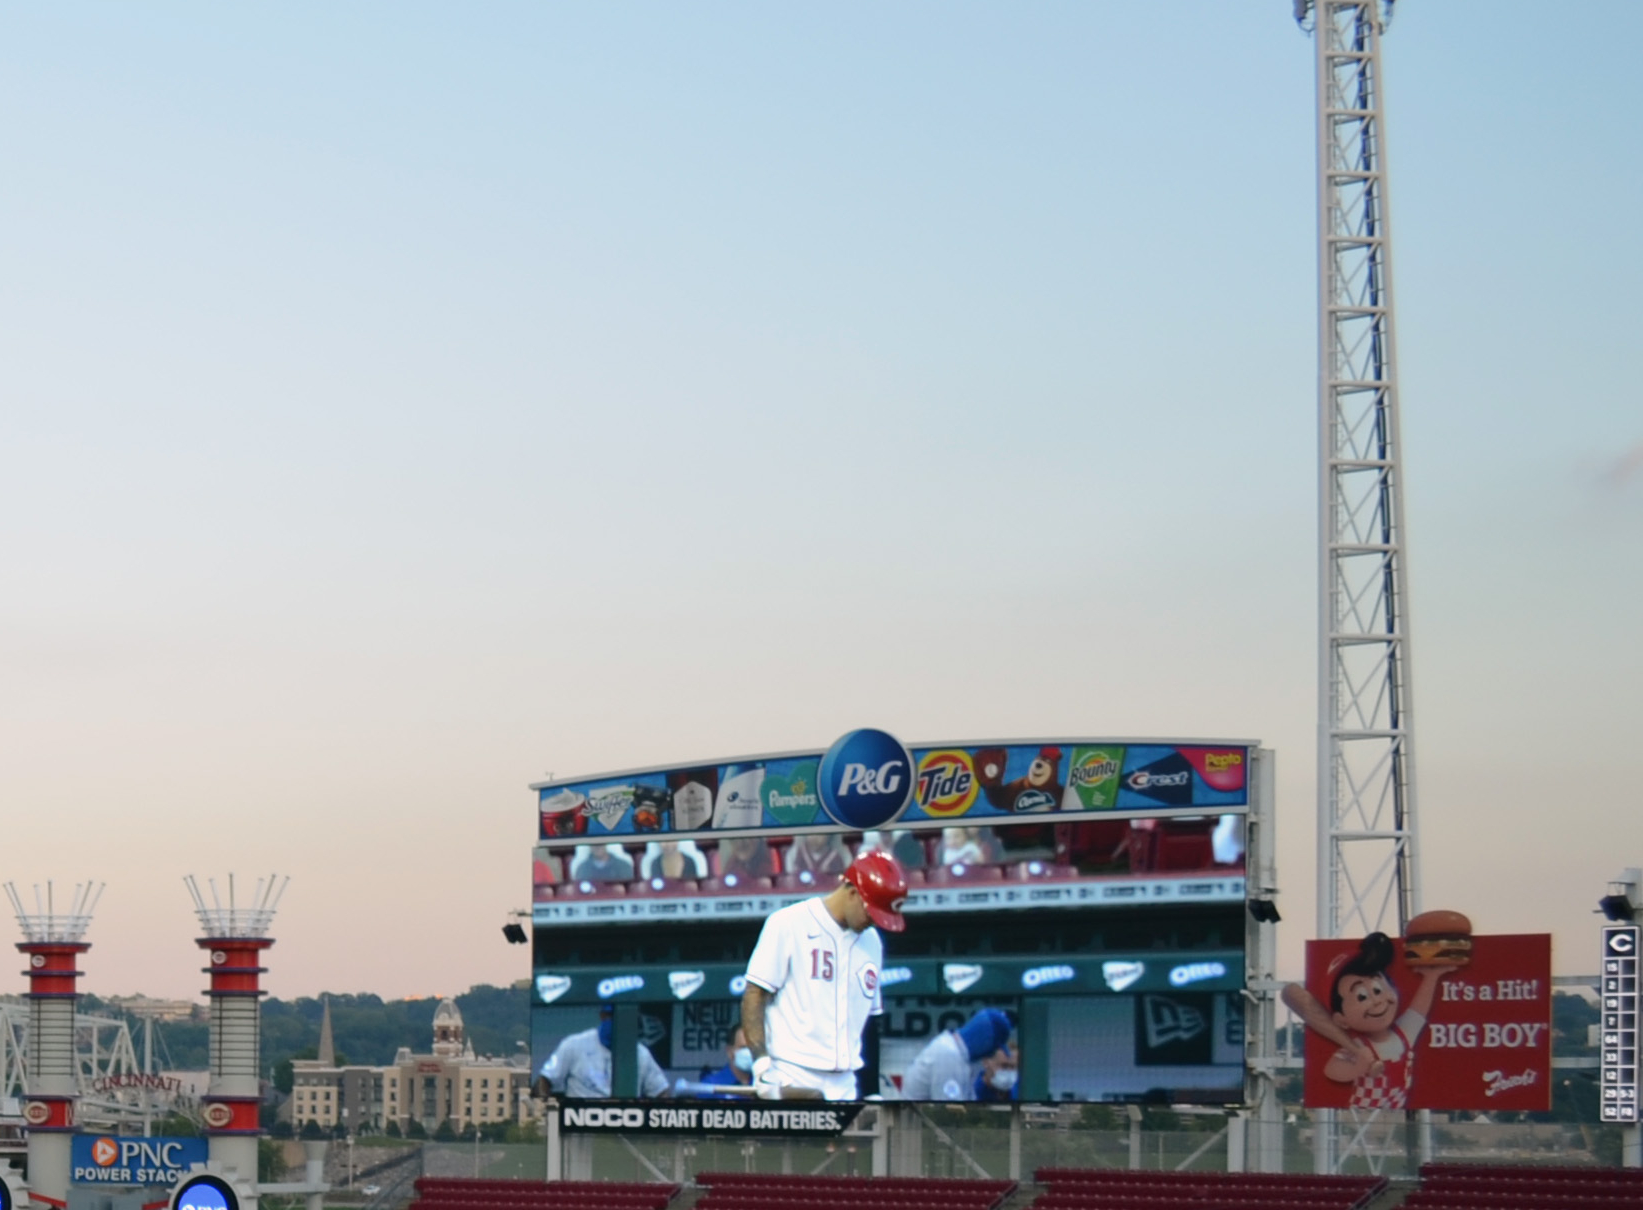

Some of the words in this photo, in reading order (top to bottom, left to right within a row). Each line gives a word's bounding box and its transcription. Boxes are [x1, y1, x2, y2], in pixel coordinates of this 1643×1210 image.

[838, 760, 903, 796] P&G
[920, 765, 972, 806] Tide
[1069, 761, 1118, 789] Bounty
[1128, 771, 1189, 790] Crest
[769, 791, 816, 809] Pampers
[1442, 981, 1472, 1001] It's
[1496, 980, 1538, 1001] Hit!
[1429, 1023, 1478, 1048] BIG
[1483, 1022, 1540, 1047] BOY
[93, 1074, 182, 1093] CINCINNATI
[564, 1107, 644, 1128] NOCO
[649, 1109, 699, 1129] START
[702, 1110, 747, 1130] DEAD
[751, 1110, 842, 1132] BATTERIES.
[121, 1142, 182, 1168] PNC
[75, 1167, 131, 1182] POWER
